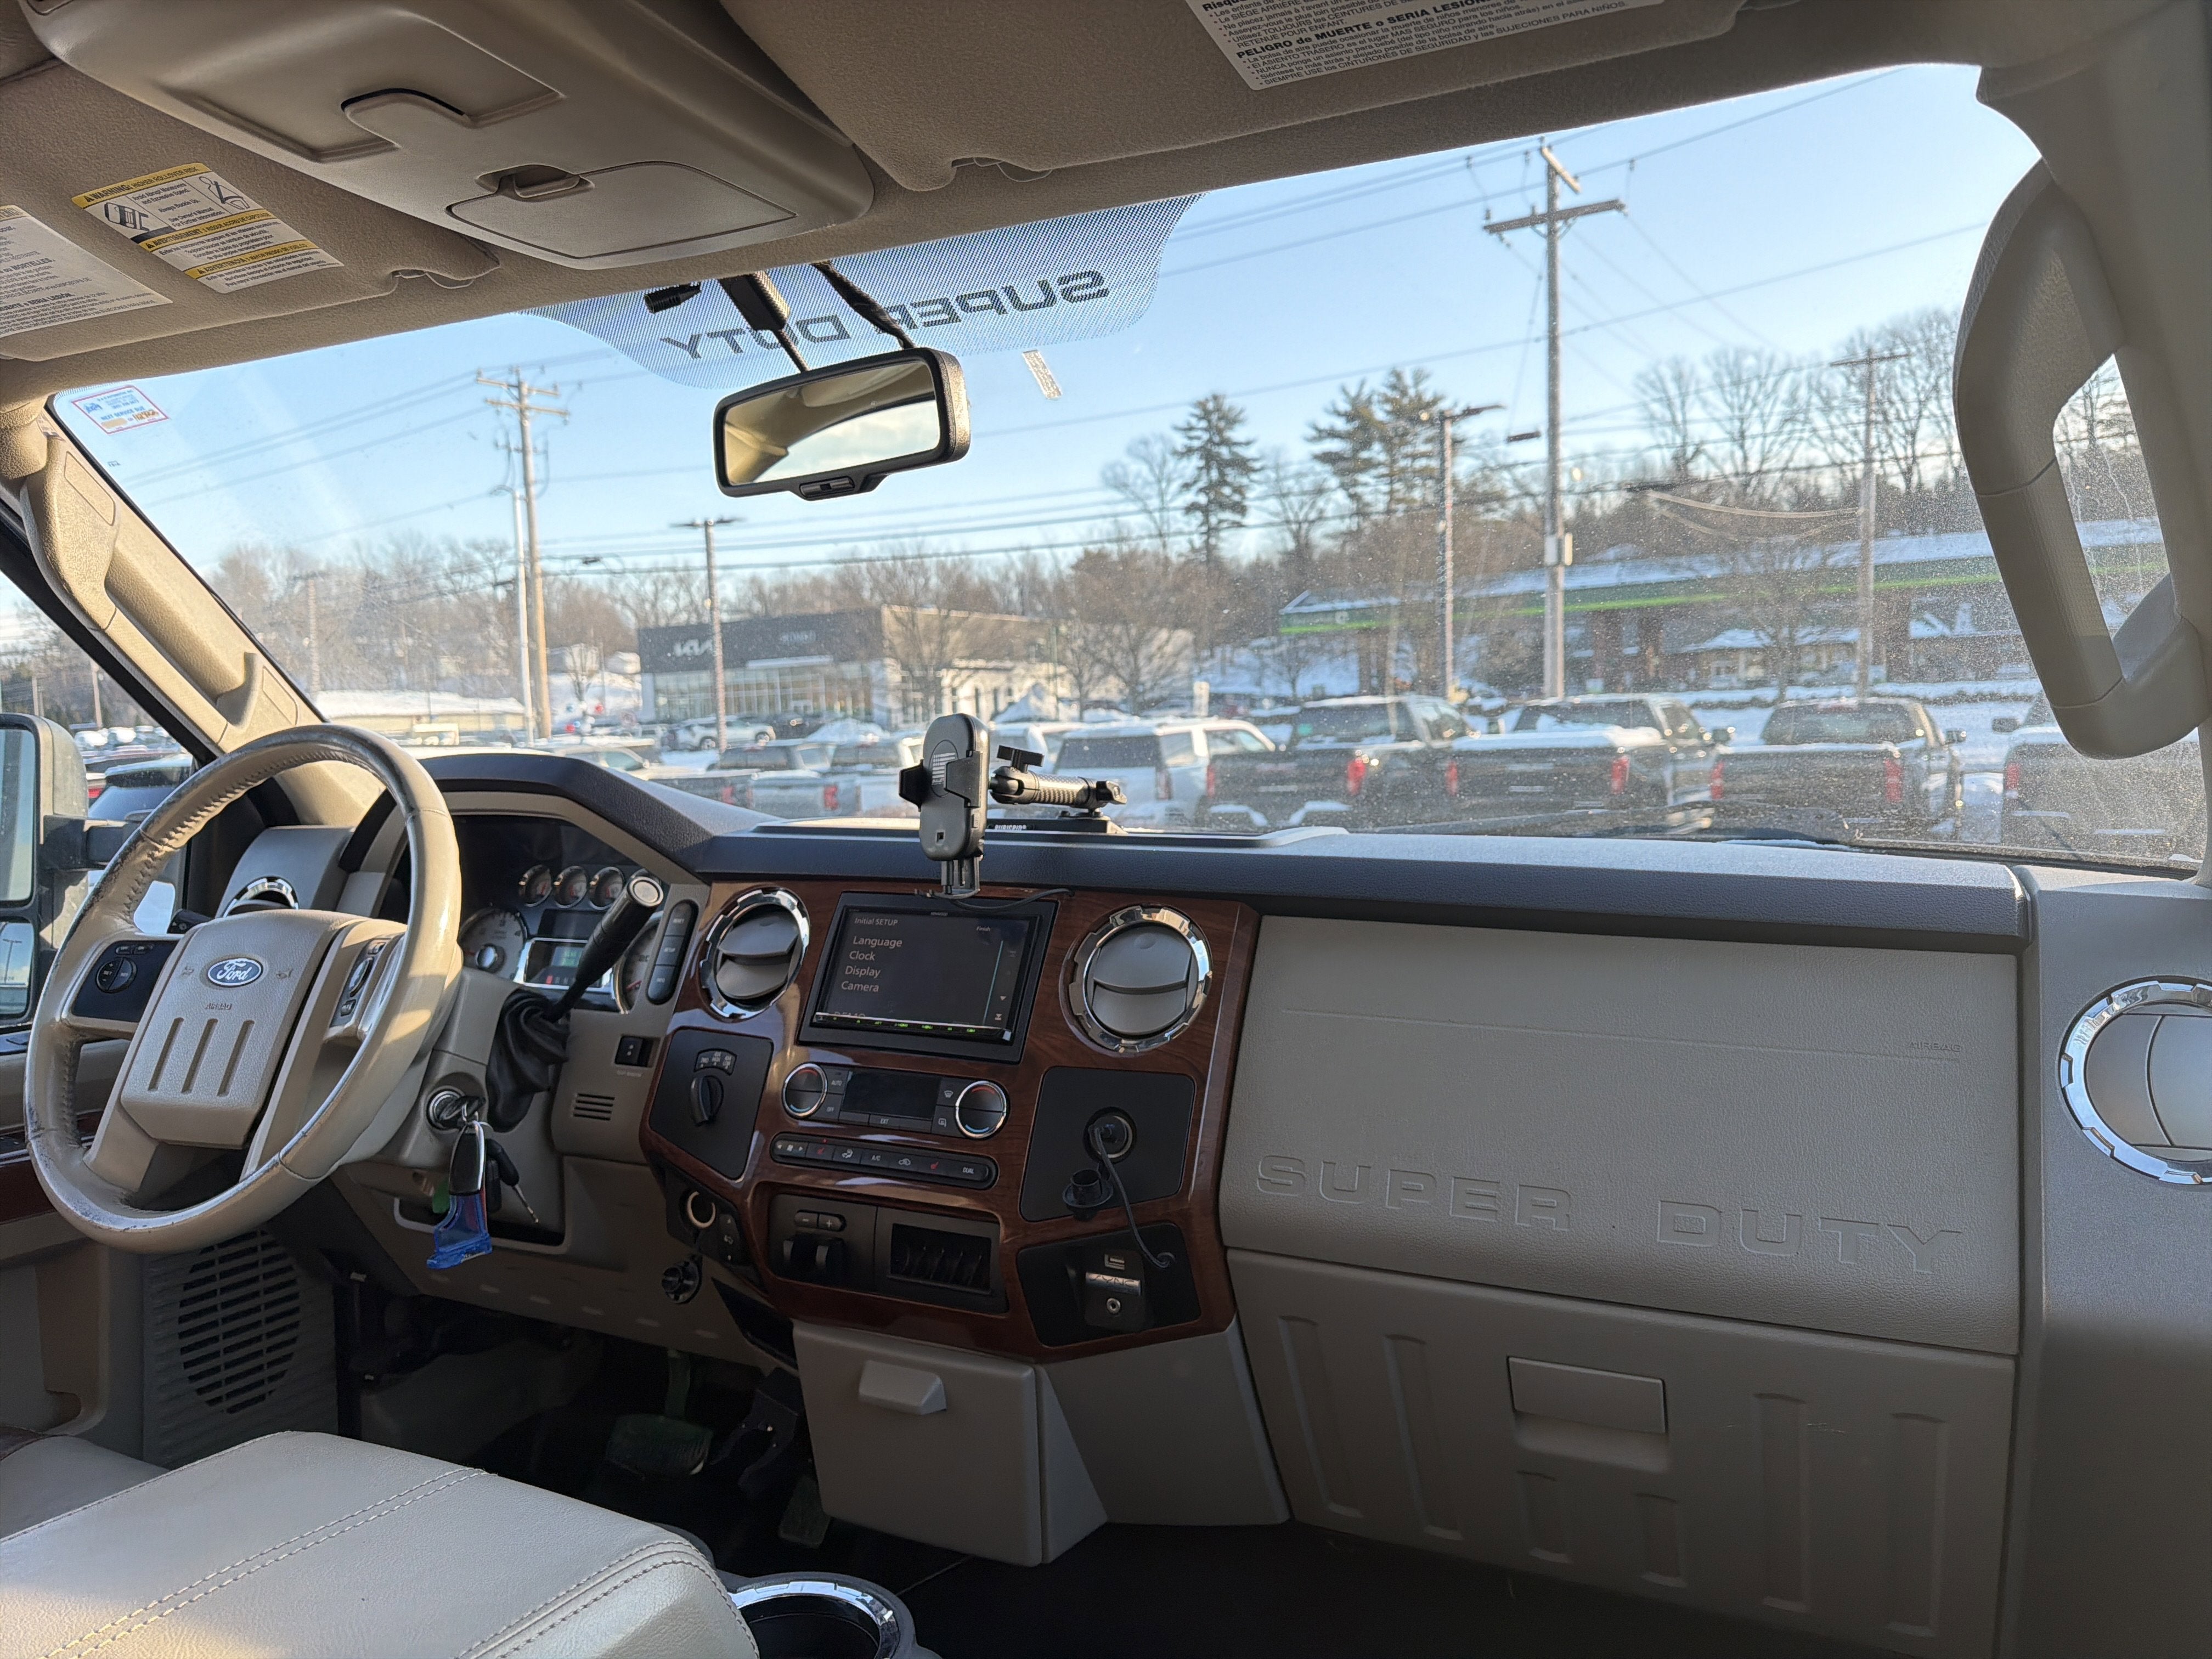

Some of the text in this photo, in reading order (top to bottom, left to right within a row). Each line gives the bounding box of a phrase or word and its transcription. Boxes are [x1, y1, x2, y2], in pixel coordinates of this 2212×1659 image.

[1213, 8, 1231, 17] Les
[1230, 0, 1263, 13] enfants
[1227, 19, 1285, 37] Asseyez-vous
[1294, 12, 1313, 21] plus
[1312, 8, 1329, 16] loin
[1330, 0, 1367, 14] possible
[1229, 7, 1261, 20] SIÈGE
[1237, 15, 1265, 27] placez
[1265, 9, 1293, 20] jamais
[1232, 31, 1262, 42] Utilisez
[1263, 19, 1312, 35] TOUJOURS
[1327, 3, 1383, 20] CEINTURES
[1235, 39, 1294, 58] PELIGRO
[1295, 35, 1313, 44] de
[1314, 21, 1373, 41] MUERTE
[1385, 8, 1430, 24] SERIA
[1259, 51, 1282, 60] bolsa
[1311, 38, 1338, 49] puede
[1339, 29, 1380, 42] ocasionar
[1390, 20, 1422, 31] muerte
[1435, 10, 1461, 20] niños
[1461, 1, 1502, 14] menores
[1237, 34, 1280, 48] RETENUE
[1280, 27, 1307, 38] POUR
[1255, 63, 1286, 74] NUNCA
[1287, 58, 1312, 67] ponga
[1324, 48, 1354, 59] asiento
[1354, 44, 1373, 52] para
[1373, 38, 1396, 48] bebé
[1414, 31, 1432, 40] tipo
[1431, 26, 1451, 35] niño
[1451, 18, 1487, 30] mirando
[1487, 12, 1513, 22] hacia
[1260, 53, 1301, 66] ASIENTO
[1301, 43, 1345, 57] TRASERO
[1367, 33, 1390, 43] lugar
[1413, 18, 1457, 32] SEGURO
[1457, 14, 1479, 23] para
[1263, 71, 1304, 85] SIEMPRE
[1304, 67, 1324, 76] USE
[1337, 50, 1398, 69] CINTURONES
[1398, 47, 1414, 55] DE
[1414, 34, 1472, 52] SEGURIDAD
[1480, 29, 1495, 37] las
[1494, 14, 1561, 34] SUJECIONES
[1561, 8, 1590, 19] PARA
[1259, 66, 1295, 80] Siéntese
[1304, 61, 1322, 69] más
[1323, 56, 1345, 65] atrás
[1351, 48, 1383, 60] alejado
[1383, 41, 1415, 53] posible
[1437, 30, 1463, 40] bolsa
[89, 184, 133, 199] WARNING:
[131, 179, 154, 187] HIGHER
[153, 170, 184, 181] ROLLOVER
[855, 917, 898, 926] Initial SETUP
[853, 936, 902, 949] Language
[849, 951, 876, 961] Clock
[216, 960, 252, 980] Ford
[845, 966, 881, 978] Display
[842, 981, 879, 992] Camera
[1908, 1041, 1961, 1053] AIRBAG
[1256, 1154, 1962, 1274] SUPER DUTY
